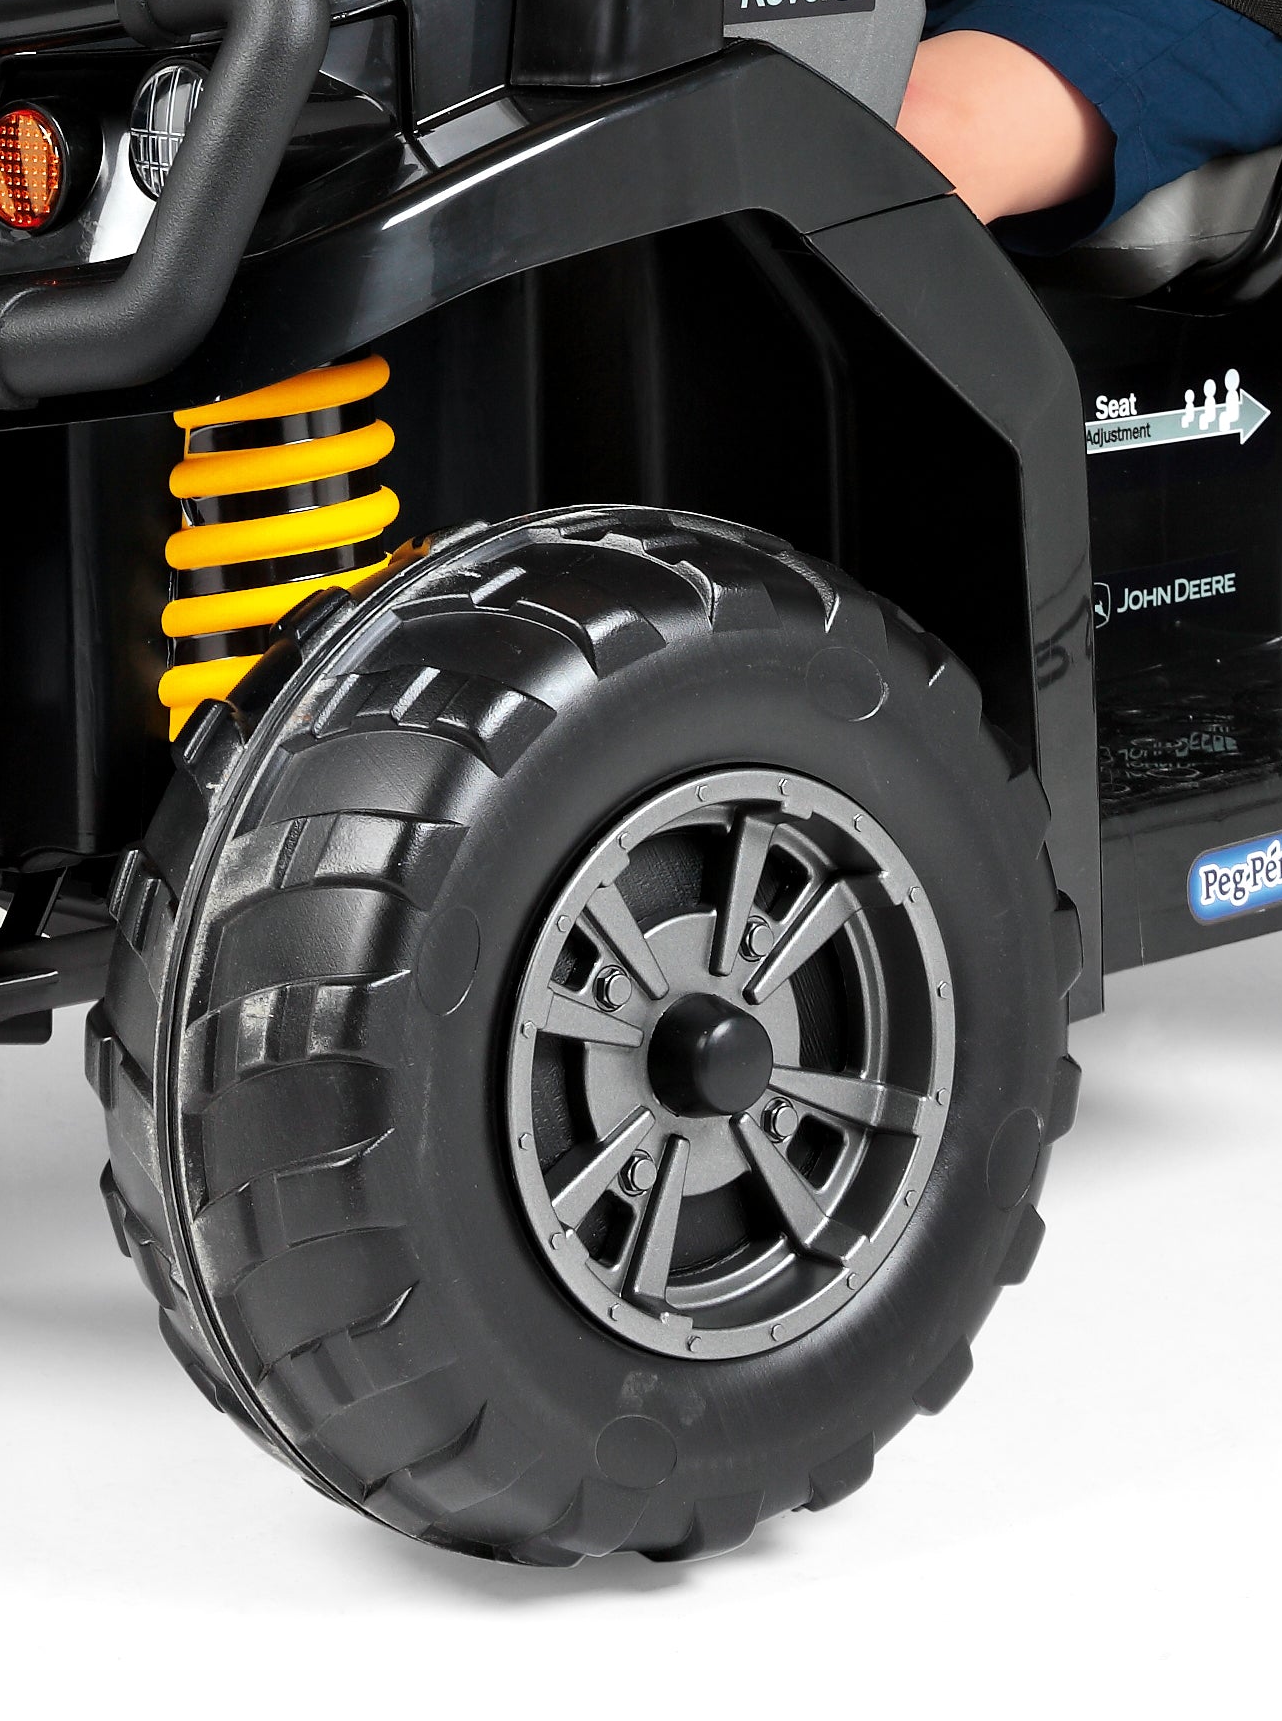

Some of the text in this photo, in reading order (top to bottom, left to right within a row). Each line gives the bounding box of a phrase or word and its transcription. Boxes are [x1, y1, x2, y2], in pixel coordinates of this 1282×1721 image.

[1095, 392, 1138, 420] Seat
[1086, 422, 1152, 448] Adjustment
[1116, 572, 1237, 613] JOHN DEERE
